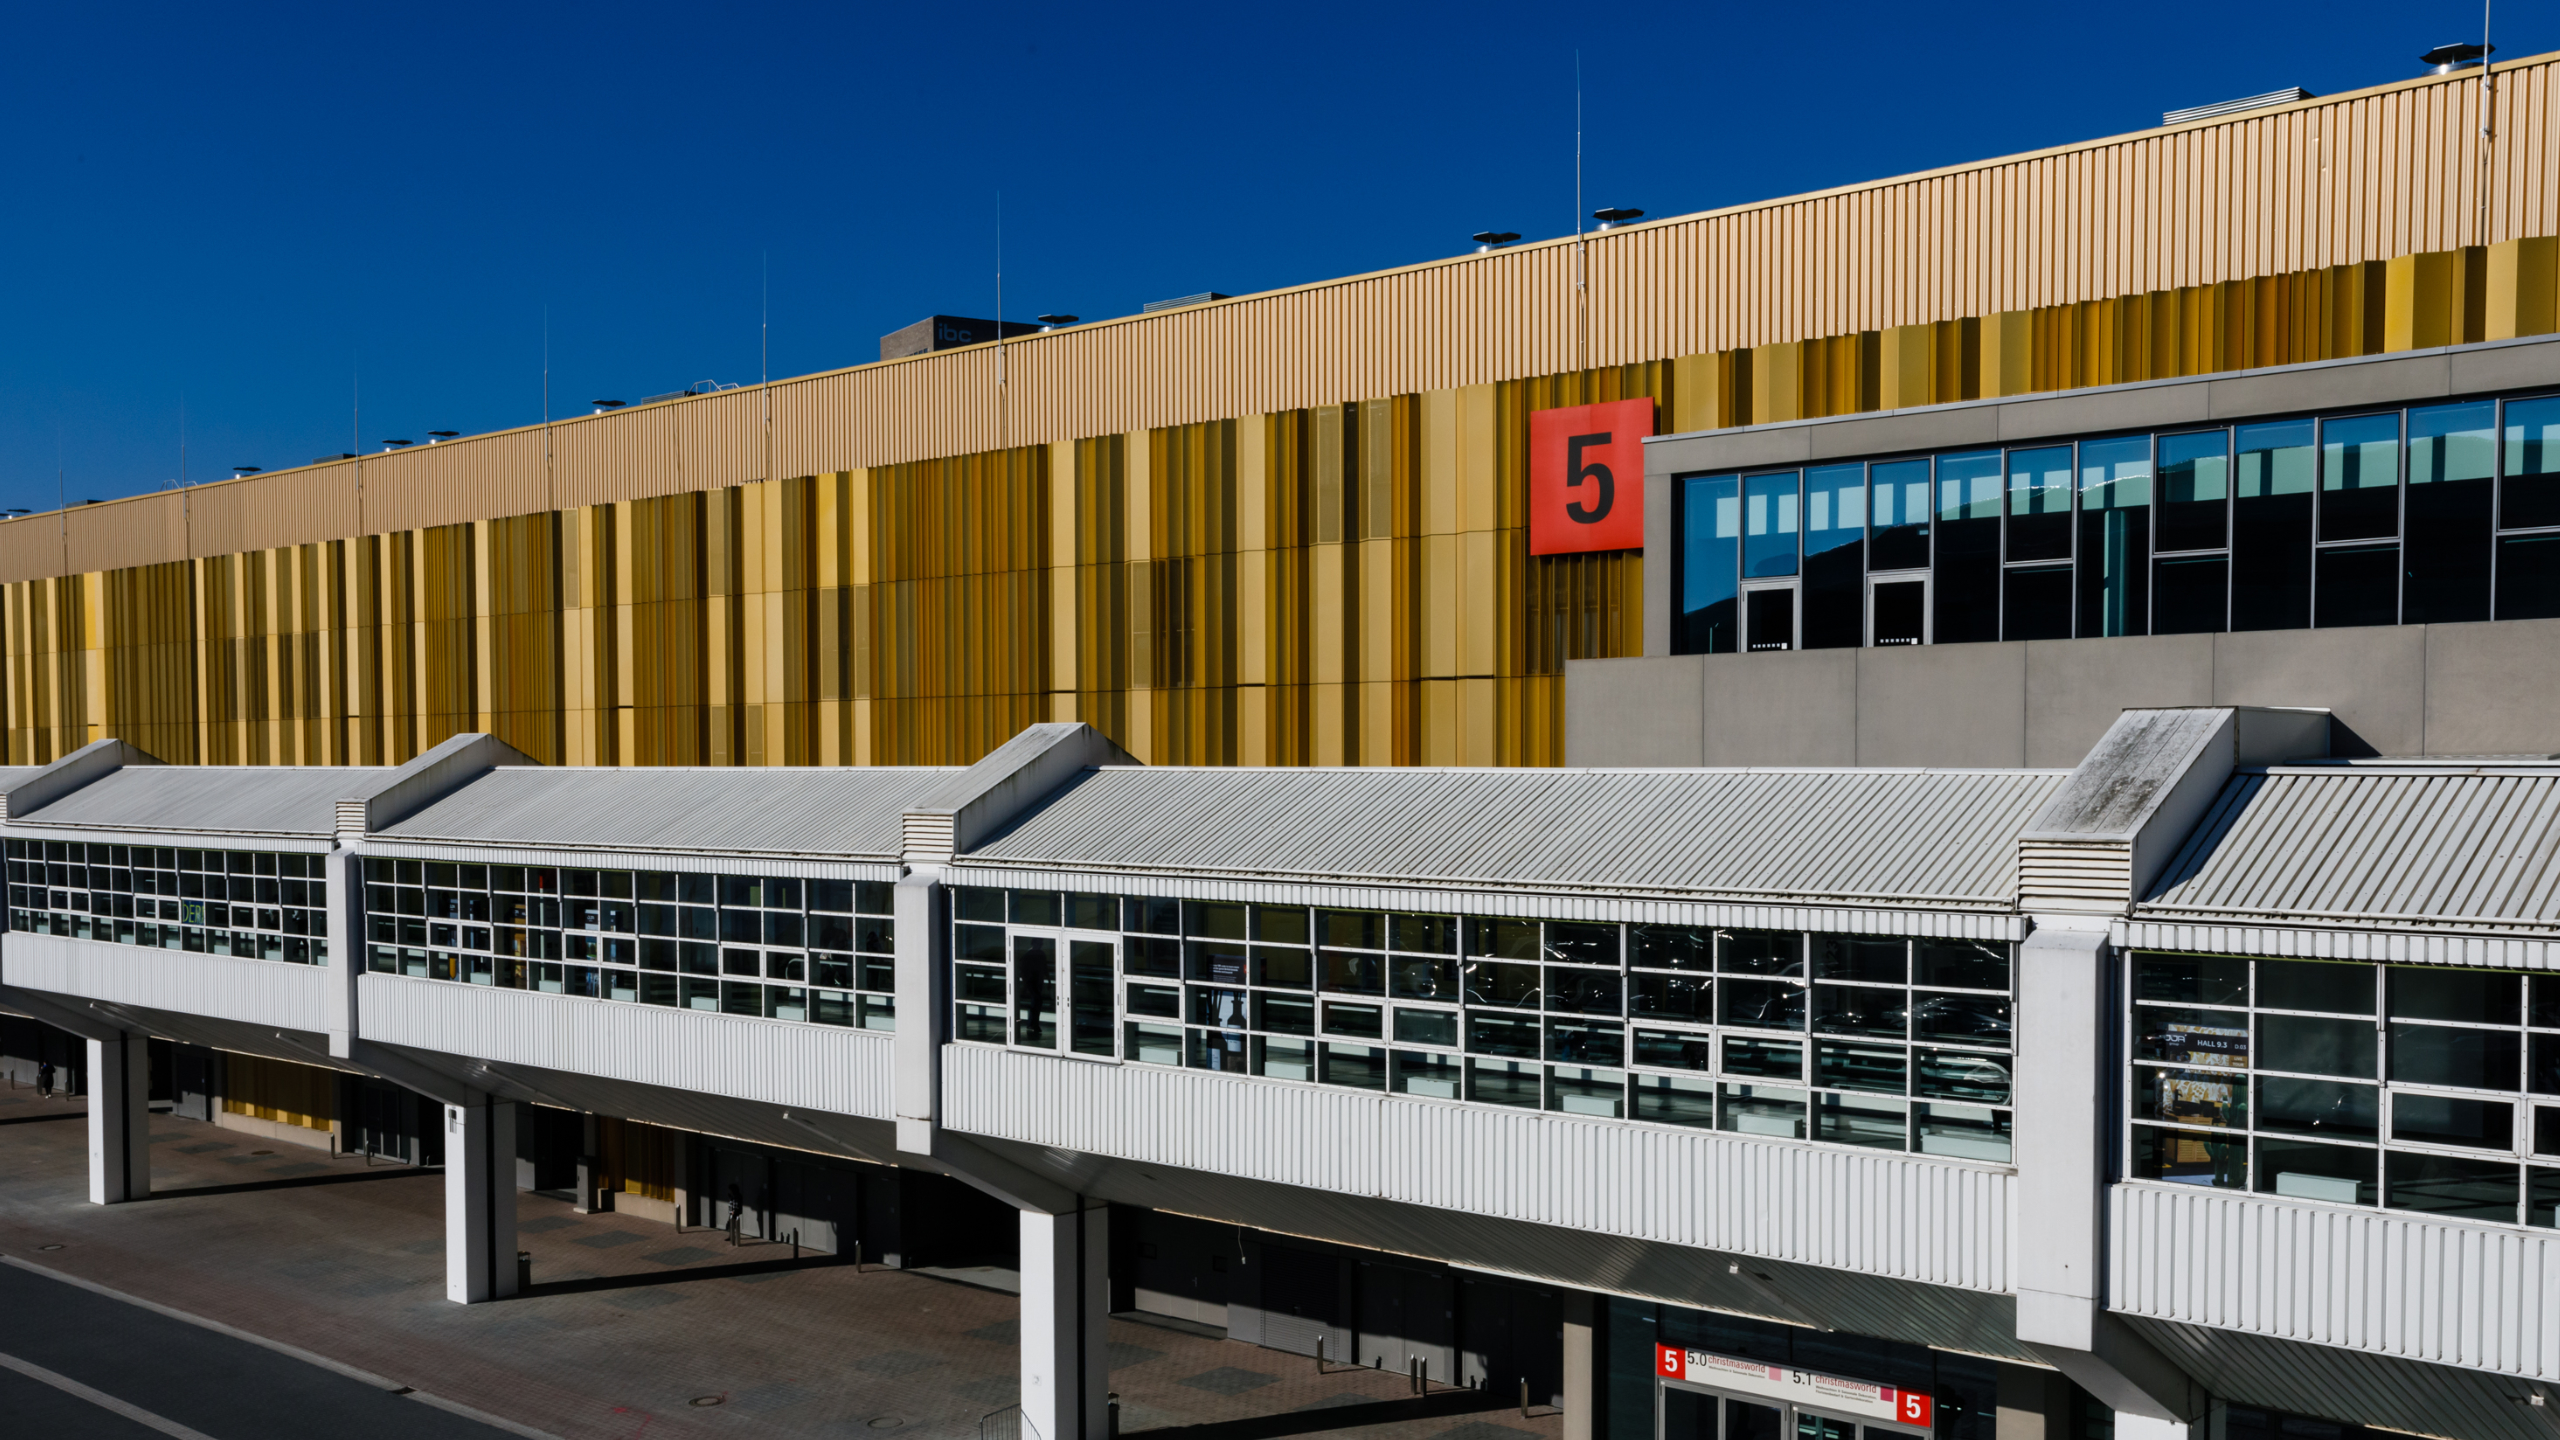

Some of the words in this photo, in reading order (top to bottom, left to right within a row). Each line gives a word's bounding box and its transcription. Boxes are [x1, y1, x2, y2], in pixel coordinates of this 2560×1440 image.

[938, 323, 972, 343] ibc
[1566, 431, 1615, 524] 5
[2197, 1039, 2216, 1048] HALL
[1664, 1350, 1678, 1372] 5
[1687, 1351, 1707, 1366] 5.0
[1708, 1355, 1766, 1373] christmasworld
[1793, 1370, 1811, 1386] 5.1
[1815, 1375, 1877, 1394] christmasworld
[1906, 1394, 1921, 1419] 5
